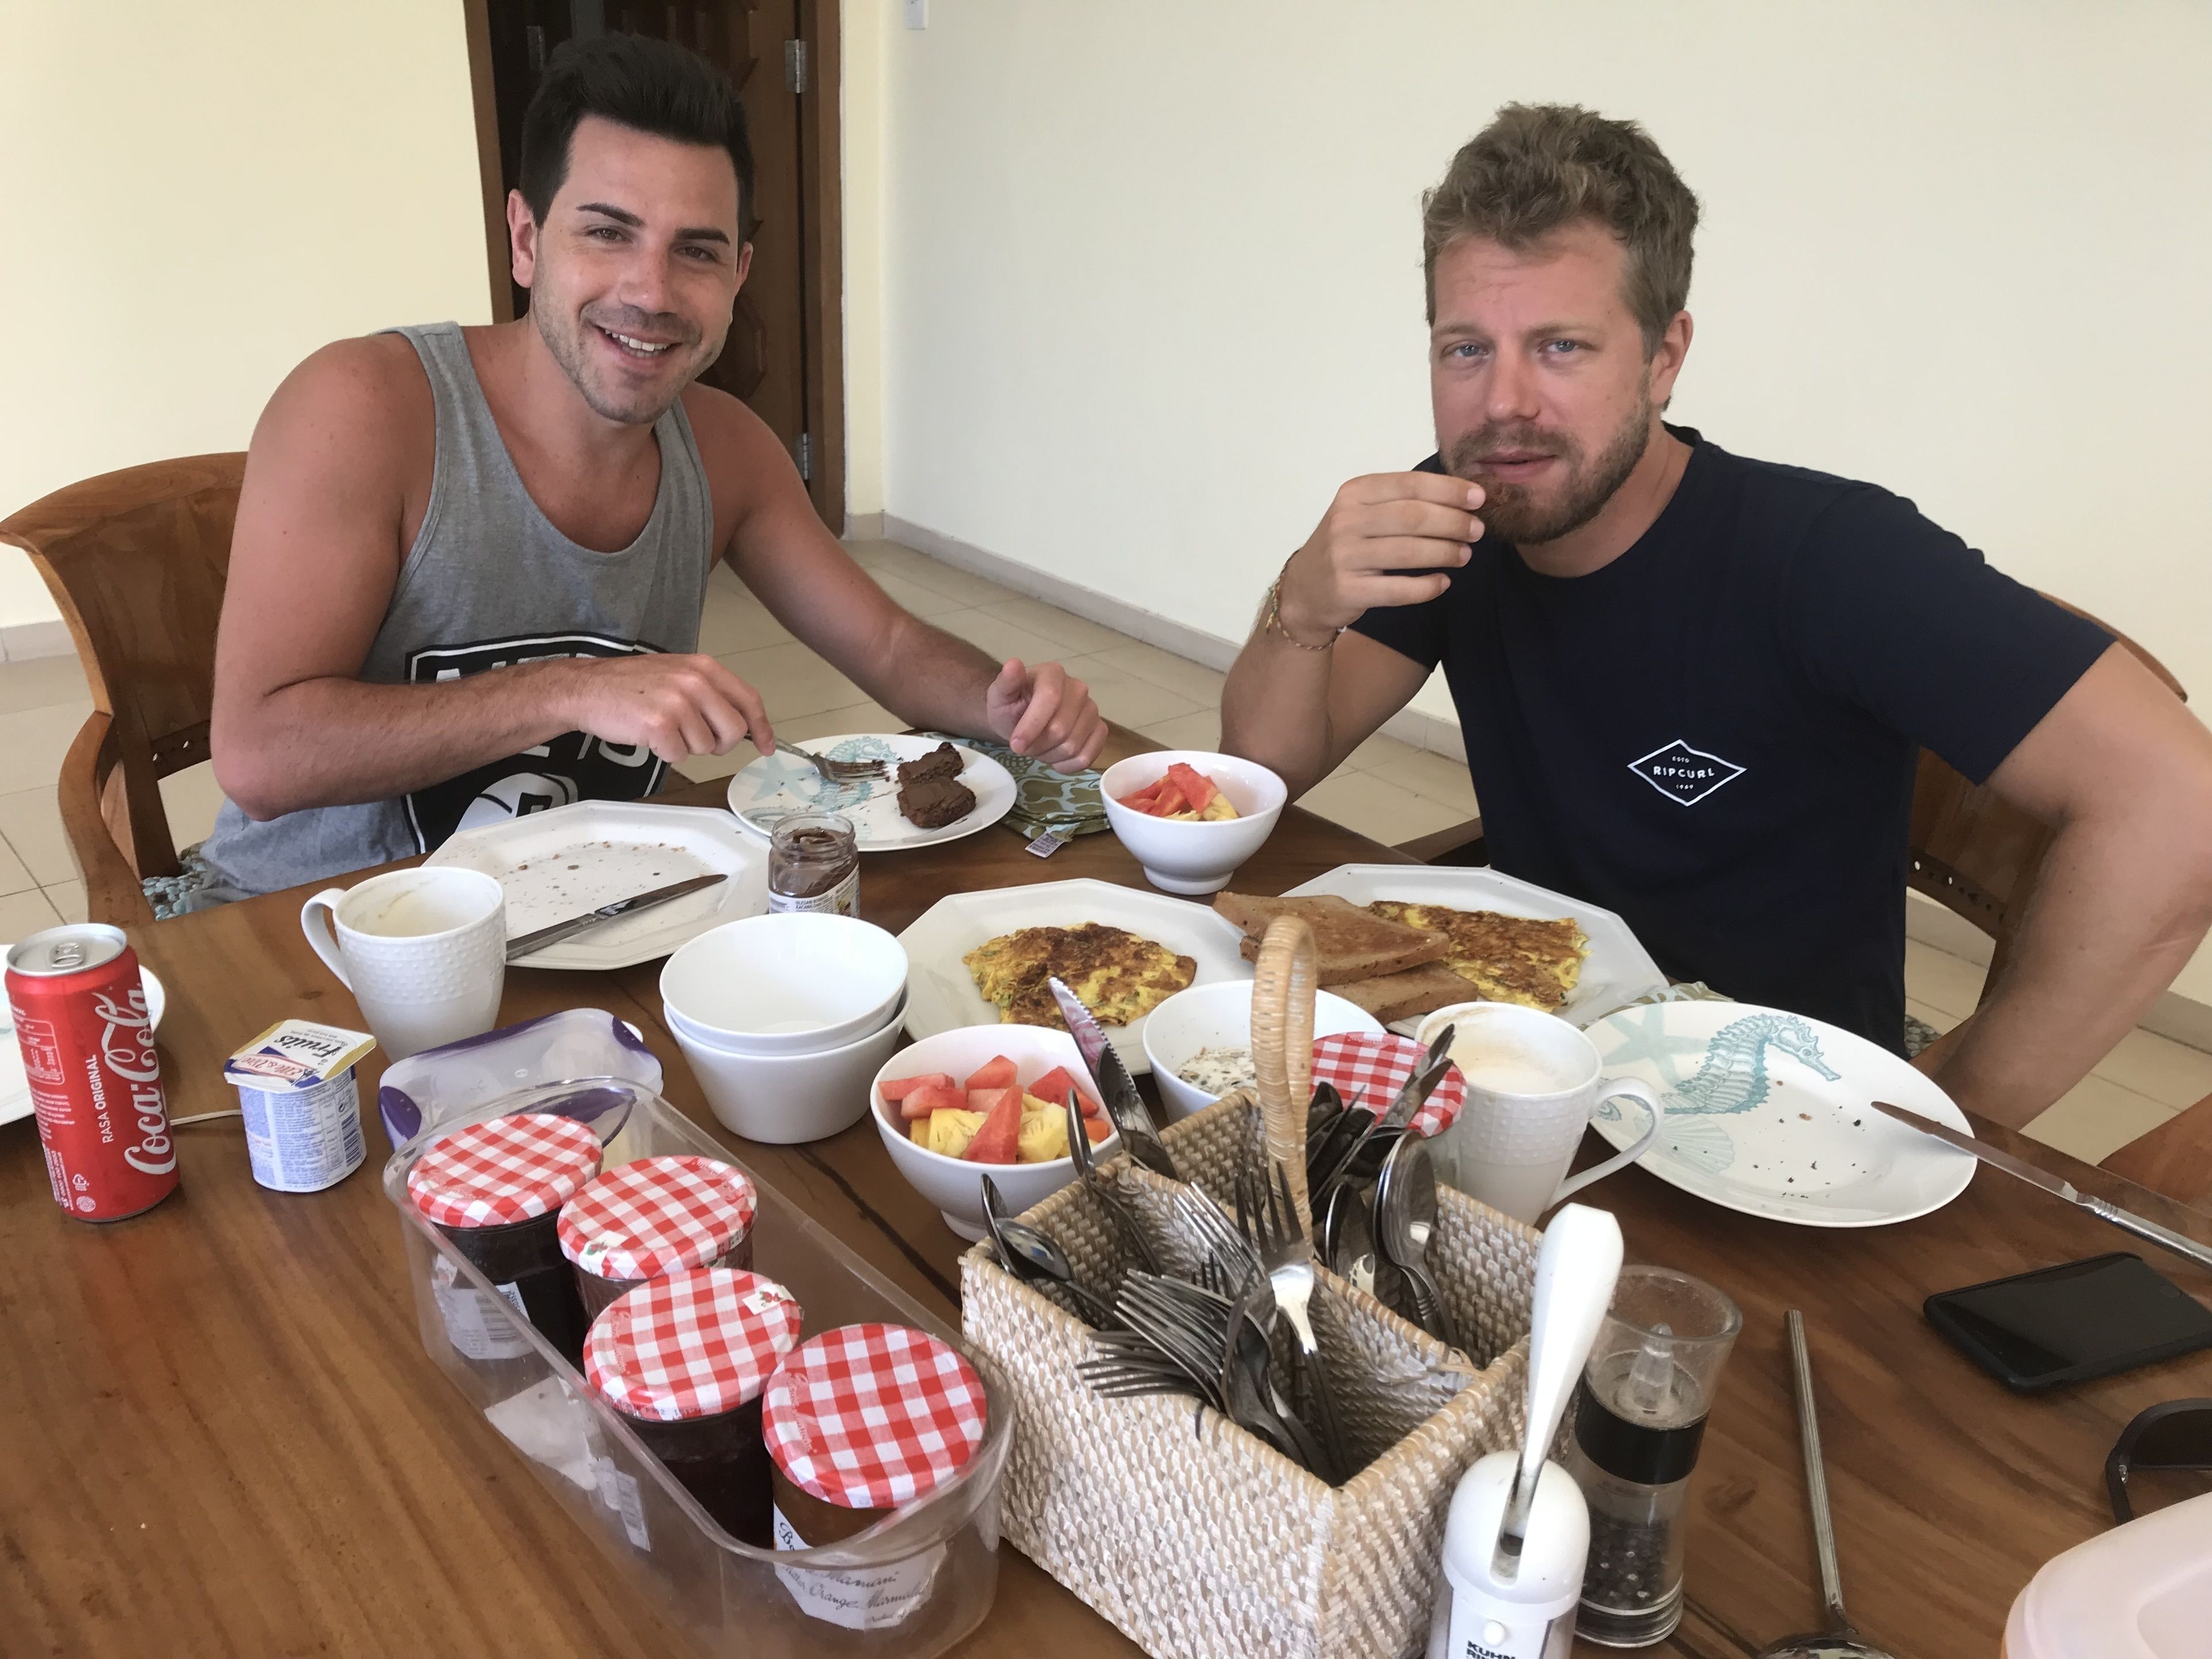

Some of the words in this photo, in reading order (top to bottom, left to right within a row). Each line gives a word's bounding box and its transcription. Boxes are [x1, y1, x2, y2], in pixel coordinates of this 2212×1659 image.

[1653, 766, 1715, 779] RIPCURL
[274, 1035, 343, 1058] Fruits
[85, 1054, 107, 1109] ORIGINAL
[97, 1112, 114, 1144] RASA
